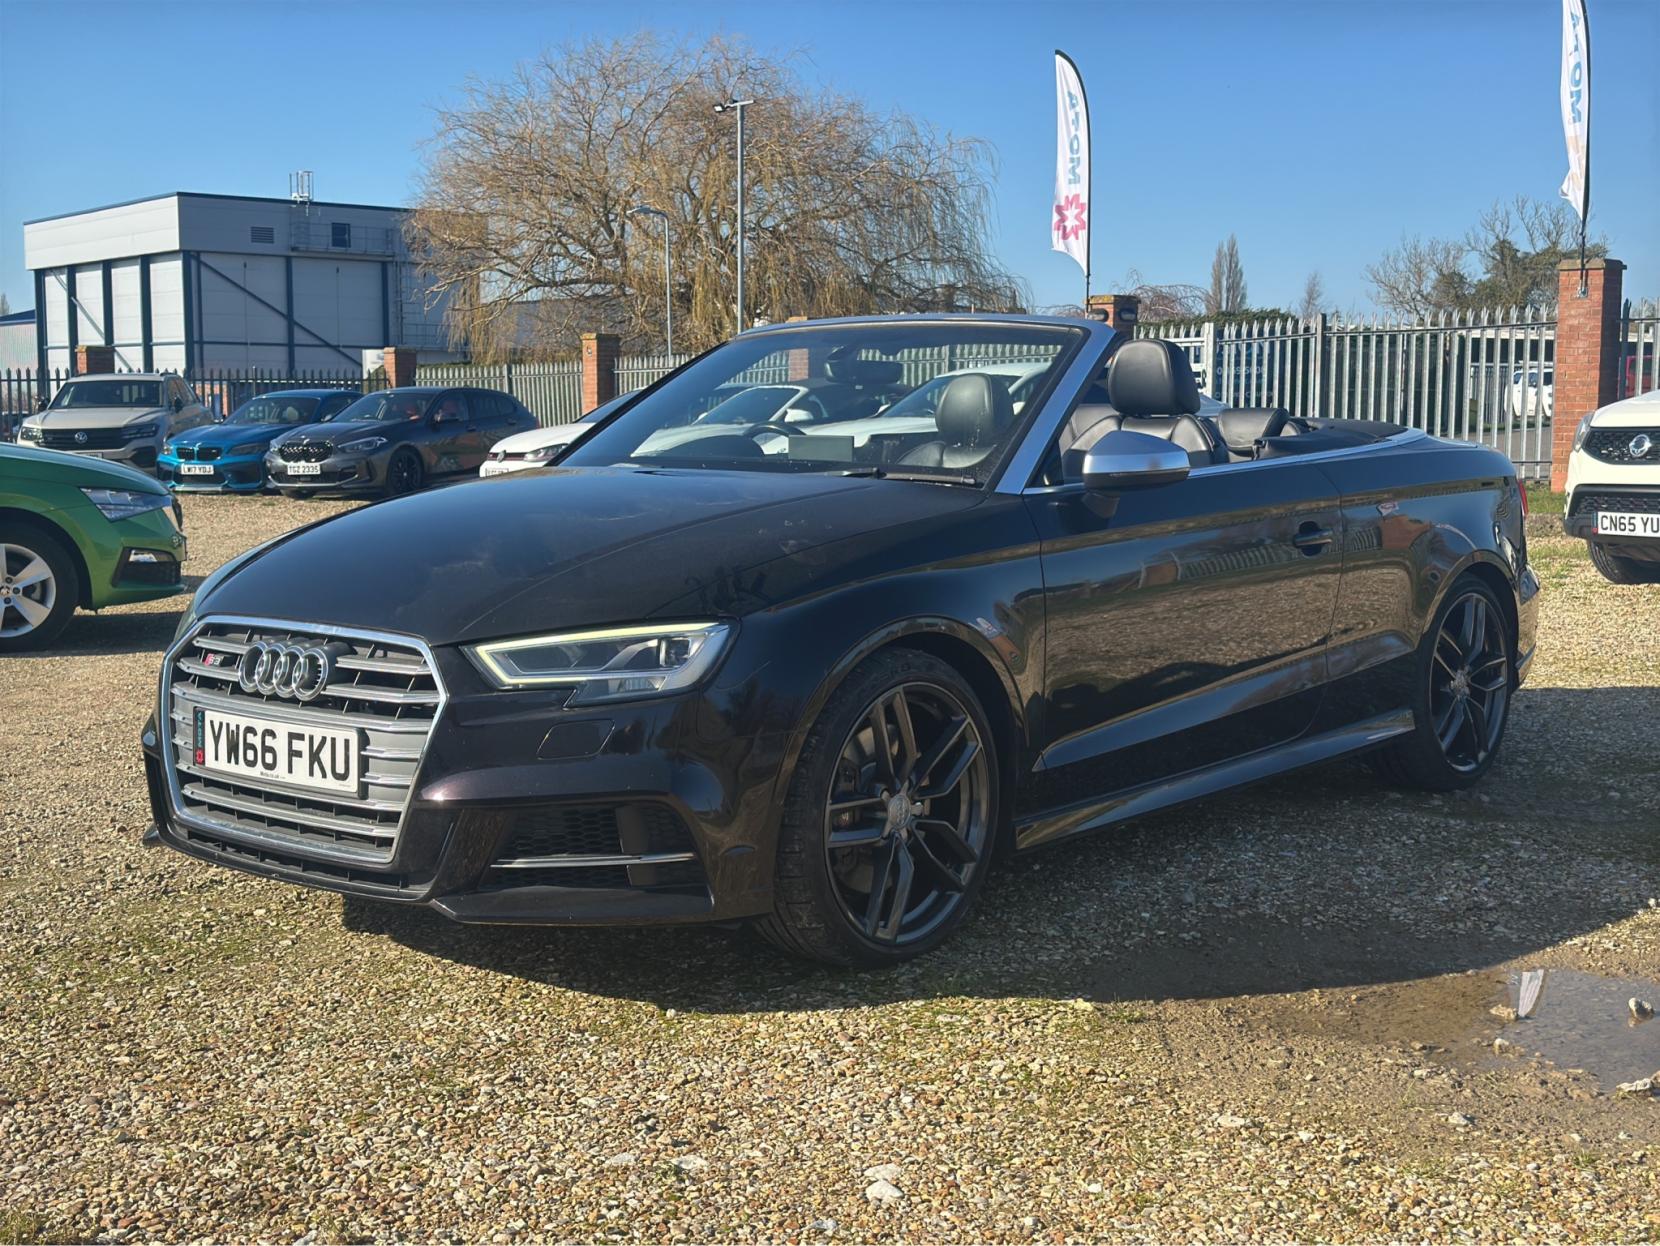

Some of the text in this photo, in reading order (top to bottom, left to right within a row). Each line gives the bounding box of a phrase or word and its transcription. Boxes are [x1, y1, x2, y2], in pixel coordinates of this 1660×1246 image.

[1601, 514, 1636, 532] CN65
[209, 720, 351, 781] YW66 FKU
